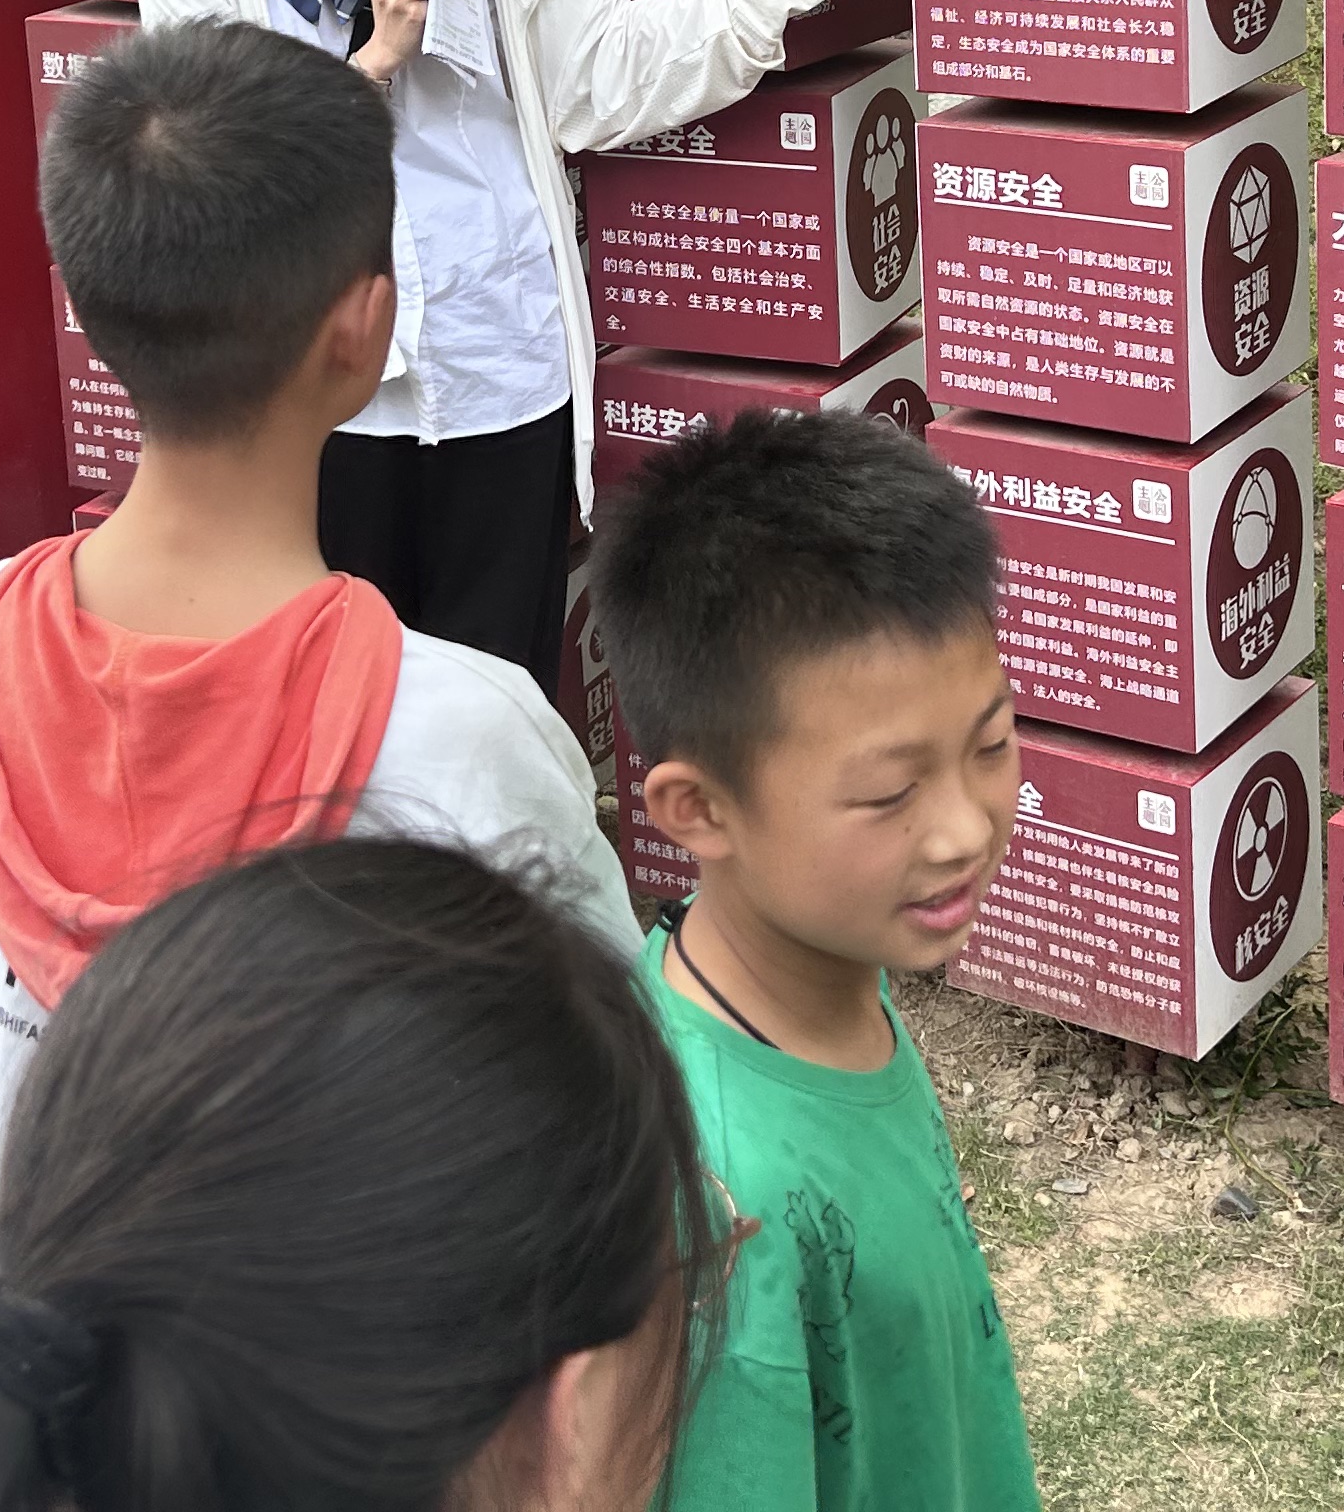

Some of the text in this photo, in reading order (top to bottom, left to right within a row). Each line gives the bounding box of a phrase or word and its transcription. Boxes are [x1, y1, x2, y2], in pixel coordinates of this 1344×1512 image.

[1233, 0, 1267, 44] 安全
[933, 61, 1032, 82] 组成部分和基石。
[933, 163, 1063, 208] 资源安全
[872, 204, 901, 253] 社会
[874, 250, 902, 294] 安全
[1234, 265, 1270, 323] 资源
[607, 315, 626, 331] 全。
[1235, 317, 1270, 367] 安全
[941, 371, 1059, 404] 可或缺的自然物质。
[1221, 553, 1290, 642] 海外利益
[1239, 614, 1274, 669] 安全
[1235, 895, 1289, 974] 核安全
